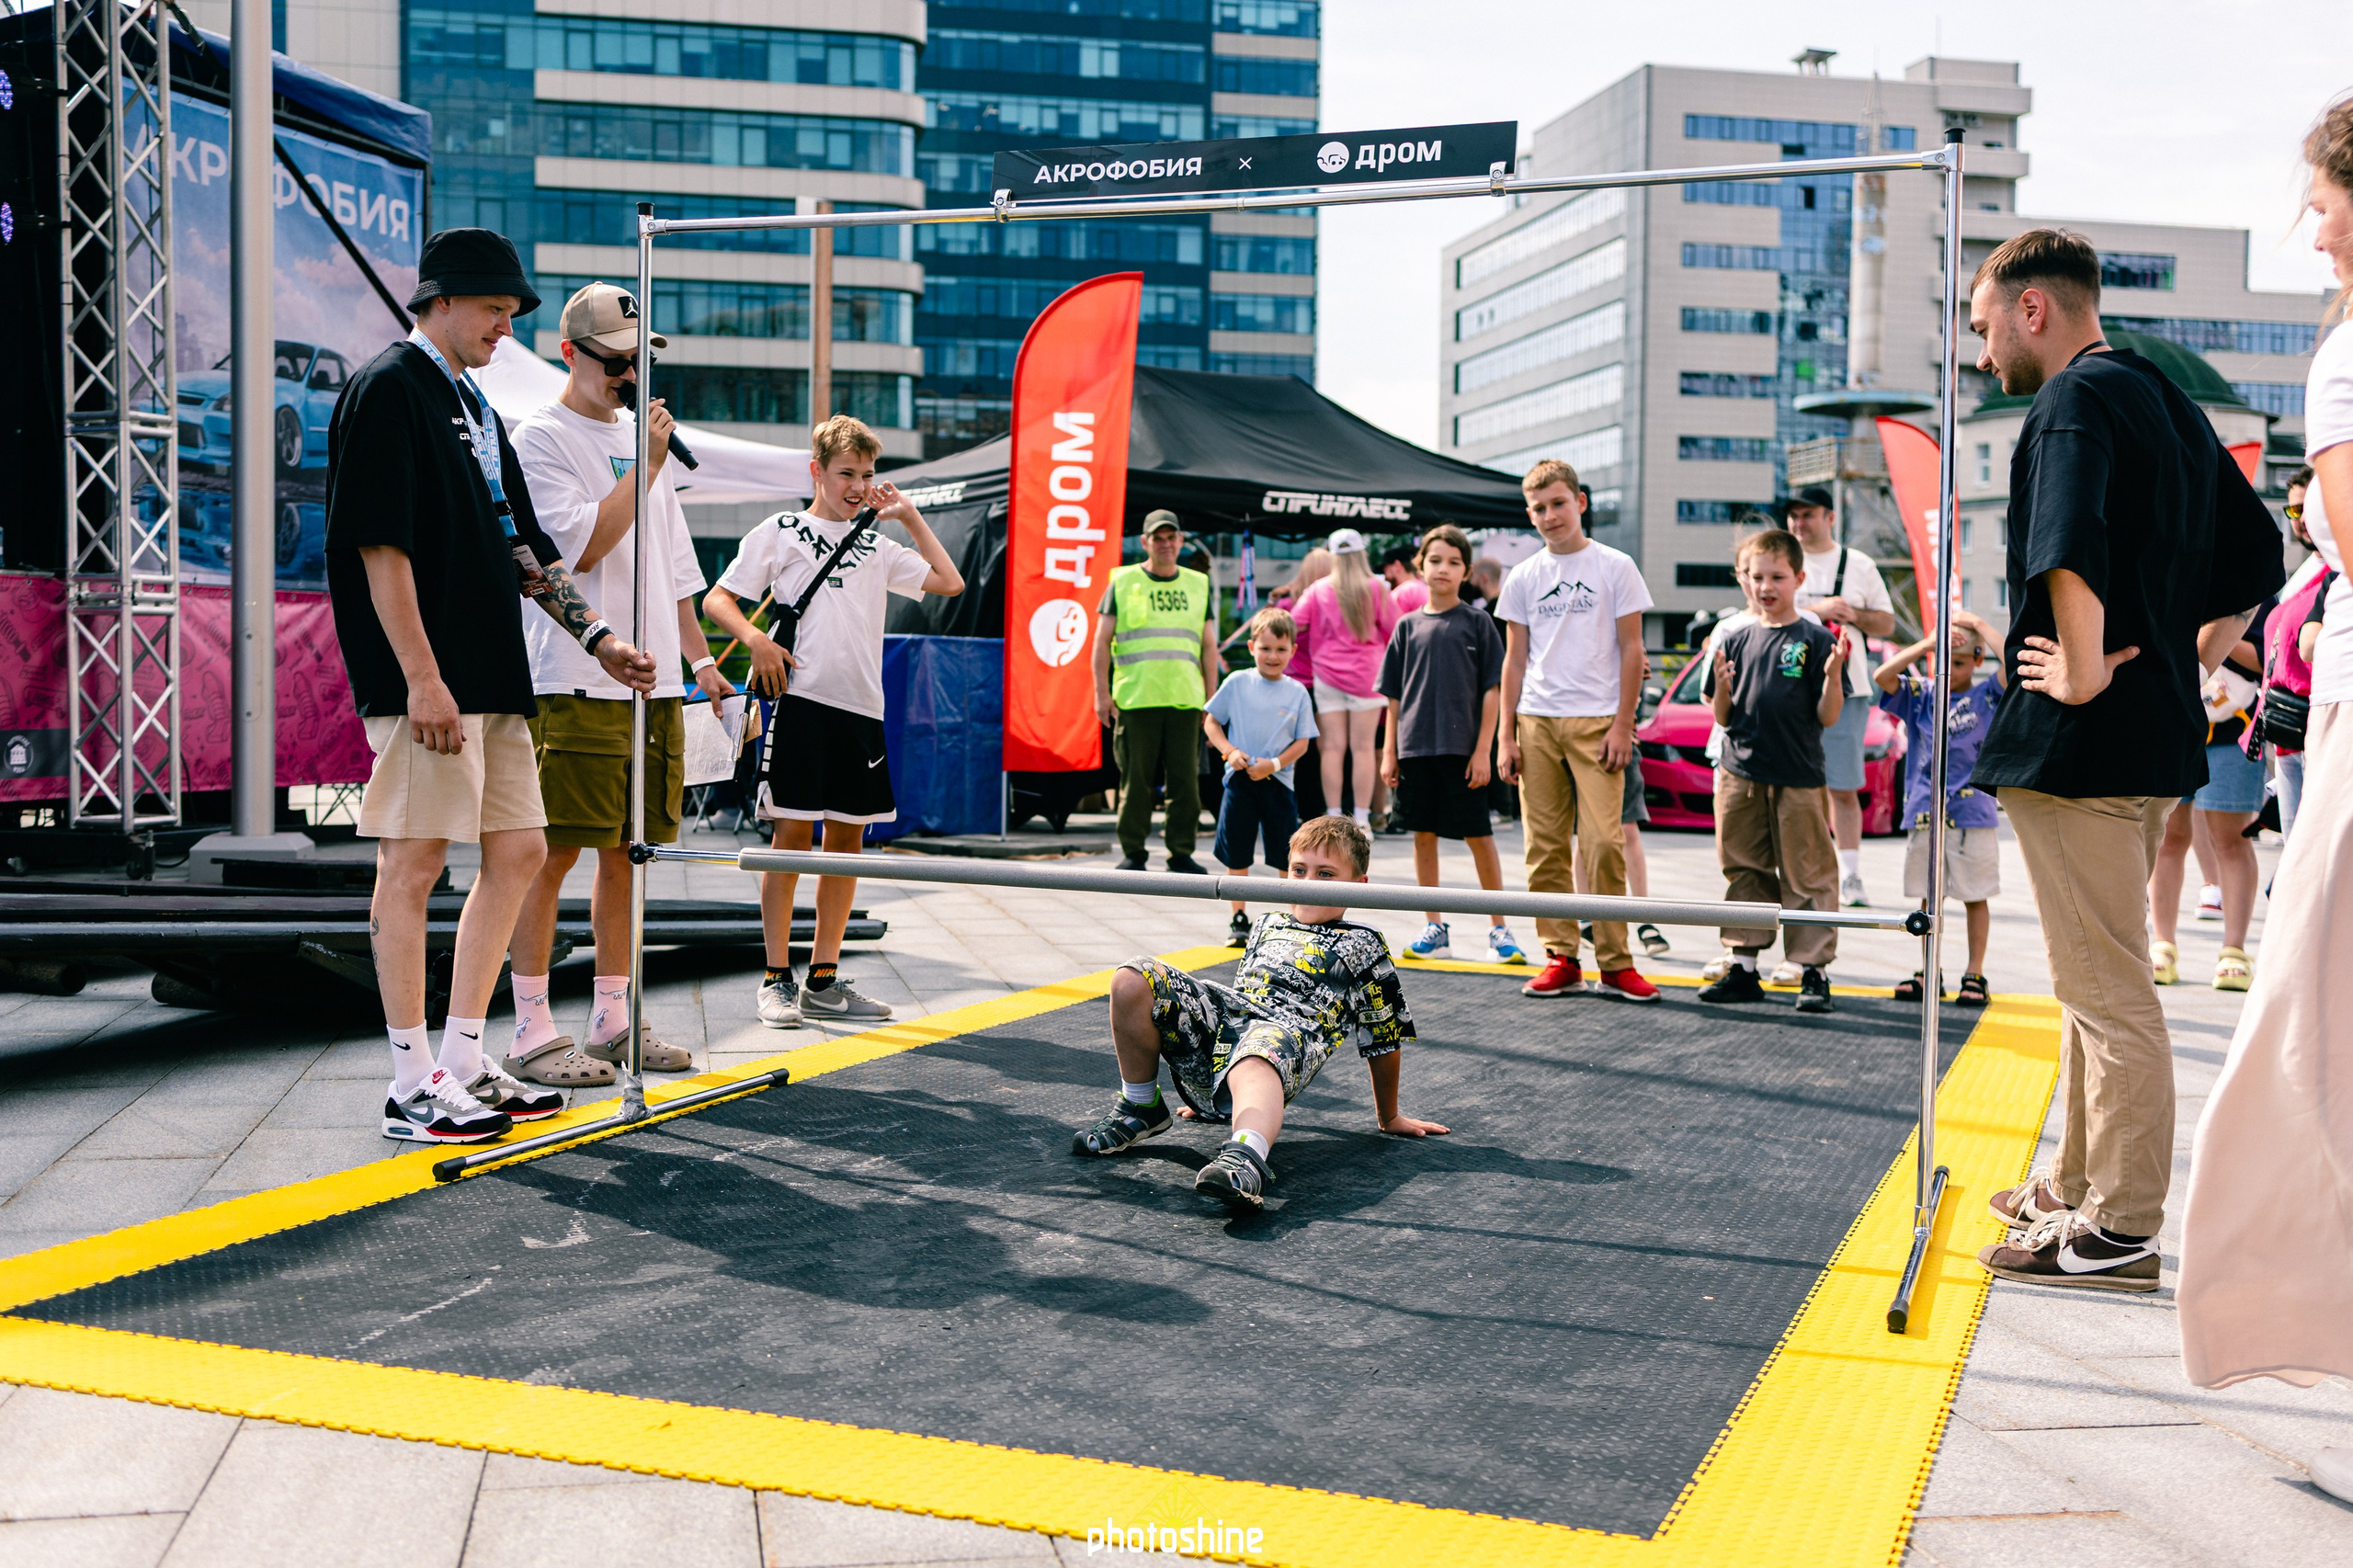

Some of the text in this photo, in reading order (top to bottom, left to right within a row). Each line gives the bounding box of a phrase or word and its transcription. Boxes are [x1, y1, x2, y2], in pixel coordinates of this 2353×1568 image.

[131, 123, 410, 243] АКРФОБИЯ
[1033, 156, 1202, 184] АКРОФОБИЯ
[1355, 140, 1442, 173] дром
[1043, 412, 1107, 589] дром
[1262, 490, 1413, 521] СПРИНГЛЕСС
[1149, 589, 1188, 611] 15369
